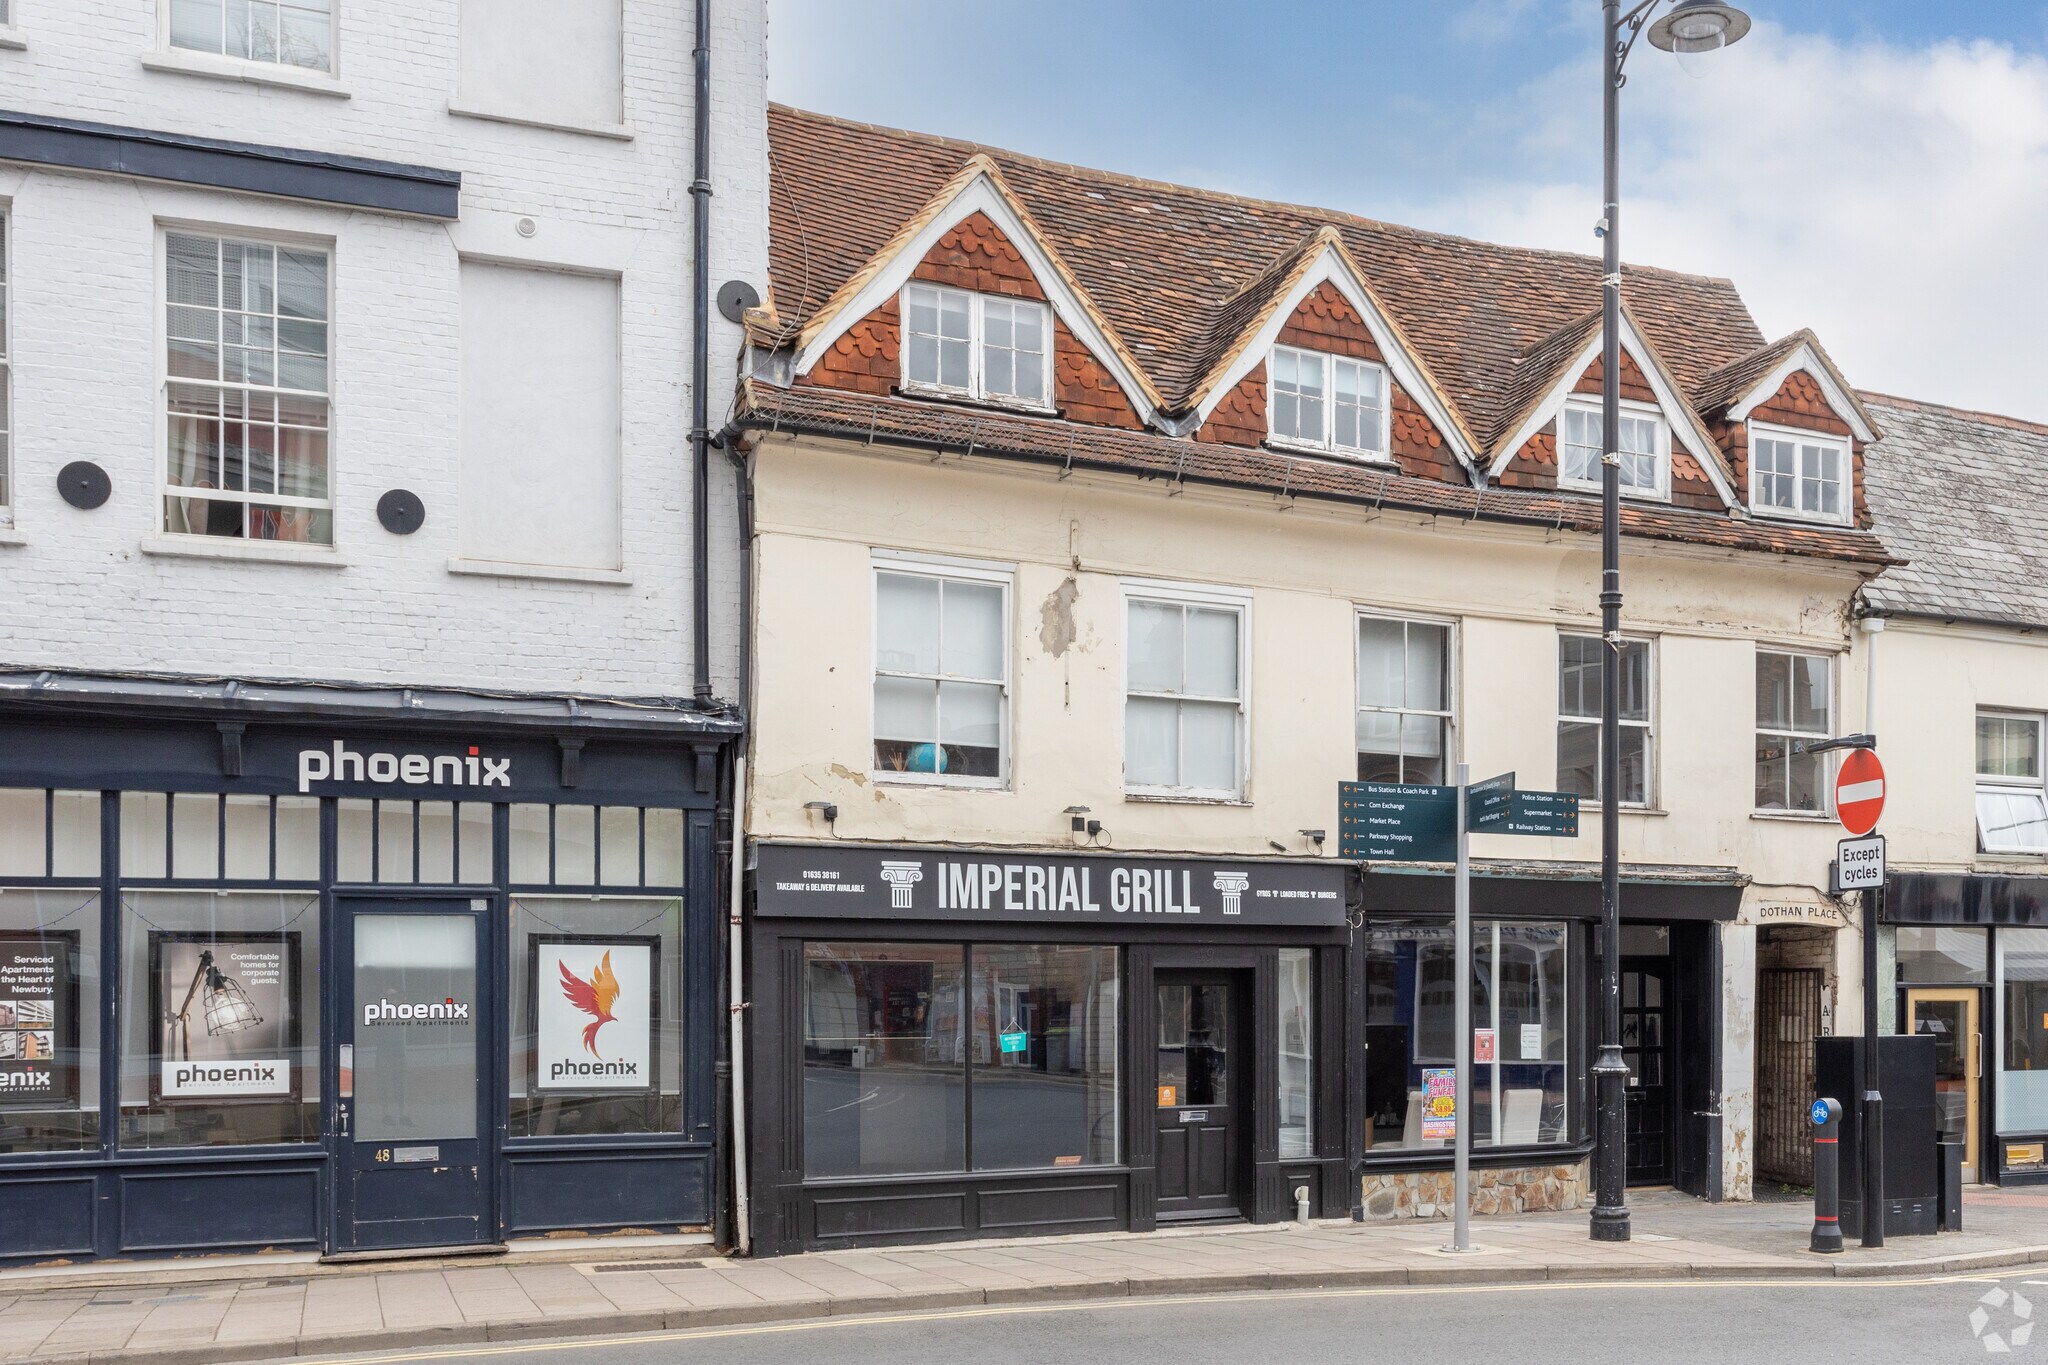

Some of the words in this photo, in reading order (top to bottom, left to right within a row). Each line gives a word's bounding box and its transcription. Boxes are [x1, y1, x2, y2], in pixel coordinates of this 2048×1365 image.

[299, 740, 510, 792] phoenix
[1368, 785, 1377, 793] Bus
[1382, 803, 1405, 811] Exchange
[1523, 809, 1552, 817] Supermarket
[1369, 817, 1387, 825] Market
[1516, 823, 1534, 832] Railway
[1369, 833, 1389, 841] Parkway
[1390, 834, 1413, 842] Shopping
[1843, 845, 1880, 862] Except
[802, 870, 821, 879] 01635
[1844, 865, 1878, 883] cycles
[775, 882, 805, 891] TAKEAWAY
[810, 883, 837, 892] DELIVERY
[836, 884, 865, 893] AVAILABLE
[938, 862, 1100, 912] IMPERIAL
[1110, 867, 1201, 914] GRILL
[1760, 907, 1802, 918] DOTHAN
[1808, 907, 1838, 919] PLACE
[14, 955, 54, 963] Serviced
[230, 953, 280, 961] Comfortable
[0, 966, 54, 974] Apartments
[0, 975, 16, 983] the
[18, 975, 43, 983] Heart
[44, 975, 54, 983] of
[250, 977, 279, 985] guests.
[11, 985, 54, 994] Newbury.
[364, 997, 469, 1026] phoenix
[551, 1057, 637, 1080] phoenix
[176, 1062, 275, 1088] phoenix
[375, 1148, 390, 1162] 48
